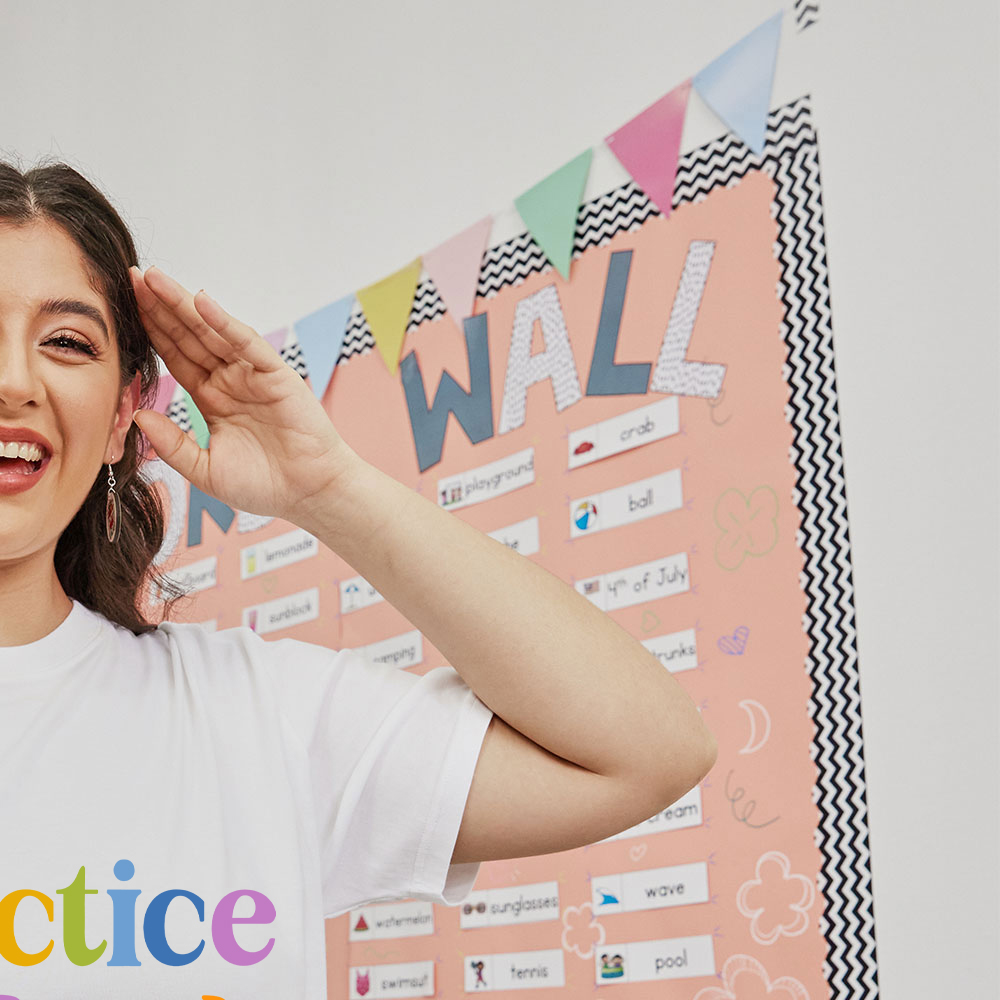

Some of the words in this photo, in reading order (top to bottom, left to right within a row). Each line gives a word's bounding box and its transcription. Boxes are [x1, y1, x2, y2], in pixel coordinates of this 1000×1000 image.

[400, 240, 728, 473] WALL
[620, 416, 656, 442] crab
[464, 456, 535, 495] playground
[628, 489, 654, 512] ball
[633, 572, 650, 593] of
[657, 565, 689, 588] July
[645, 882, 685, 898] wave
[490, 894, 558, 917] sunglasses
[511, 962, 549, 980] tennis
[655, 949, 688, 973] pool
